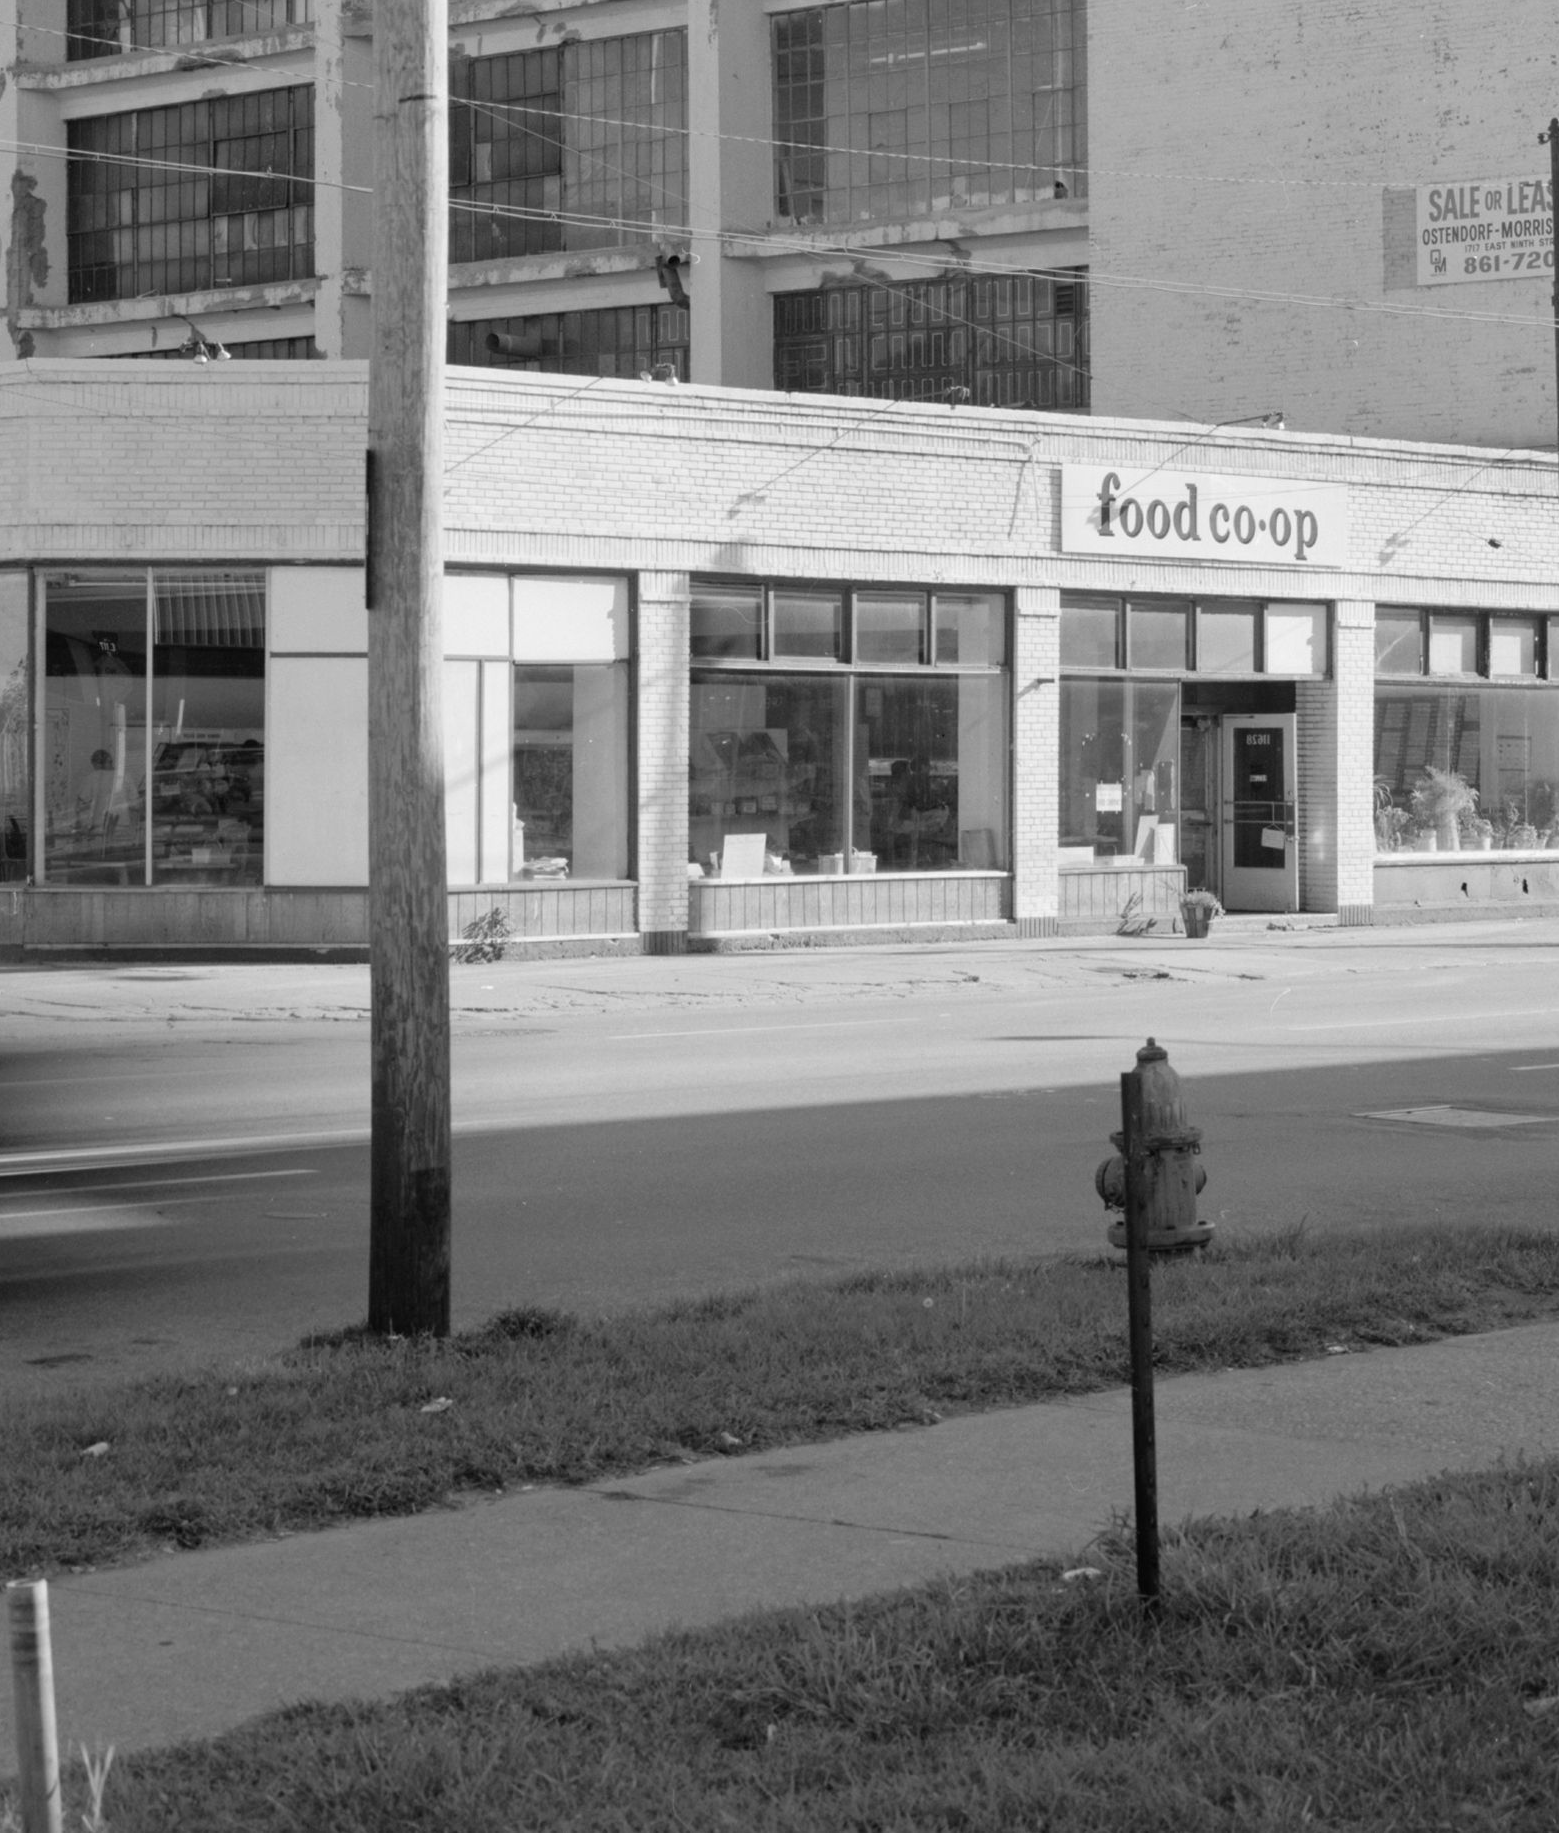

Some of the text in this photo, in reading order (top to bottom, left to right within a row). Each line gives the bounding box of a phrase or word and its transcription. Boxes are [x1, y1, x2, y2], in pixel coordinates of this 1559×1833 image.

[1429, 186, 1481, 222] SALE
[1485, 190, 1502, 211] OR
[1422, 217, 1553, 246] OSTENDORF-MORRIS
[1465, 244, 1480, 254] 1717
[1485, 241, 1506, 251] EAST
[1511, 239, 1535, 249] NINTH
[1096, 472, 1201, 541] food
